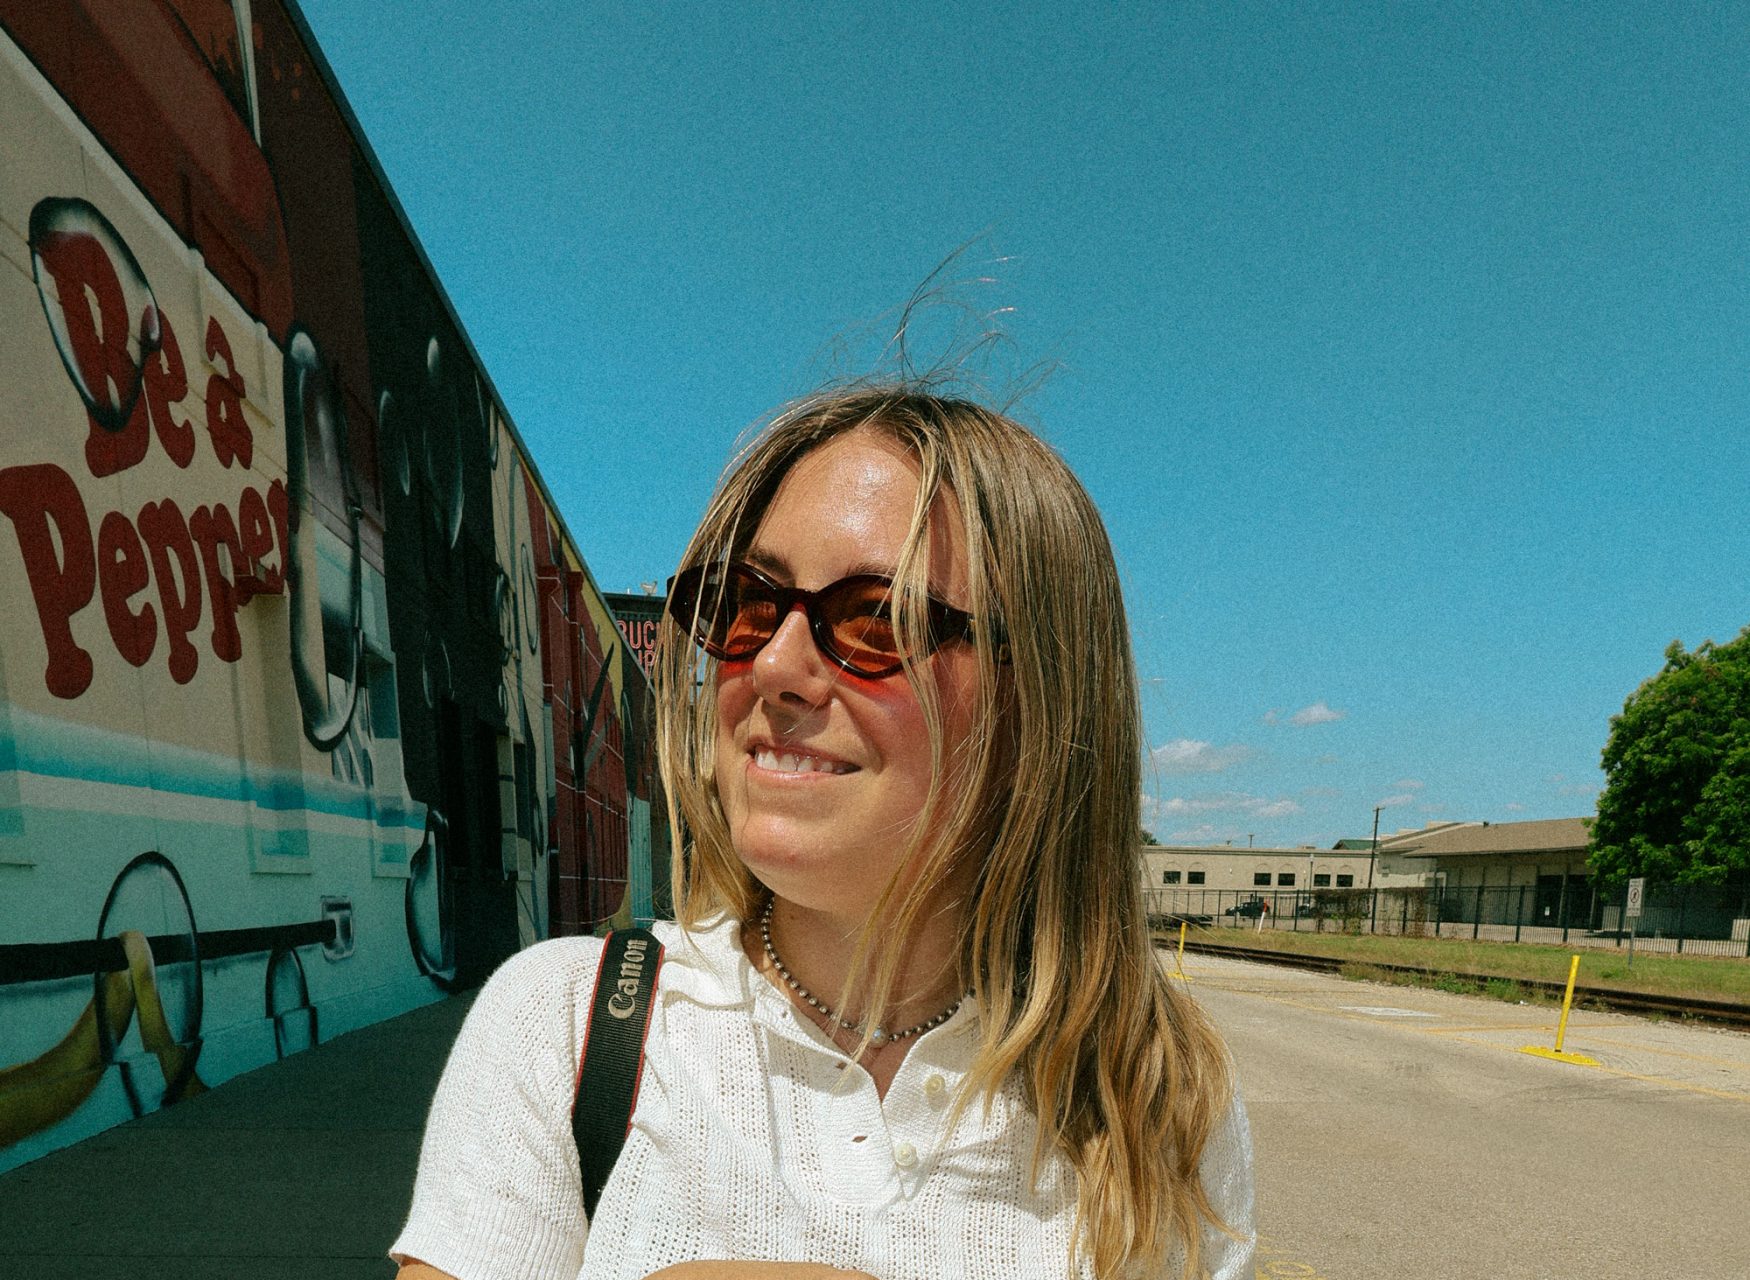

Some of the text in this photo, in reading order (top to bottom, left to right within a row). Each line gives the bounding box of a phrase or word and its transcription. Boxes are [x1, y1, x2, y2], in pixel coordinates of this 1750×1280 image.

[40, 231, 253, 478] Be a
[608, 939, 648, 1019] Canon
